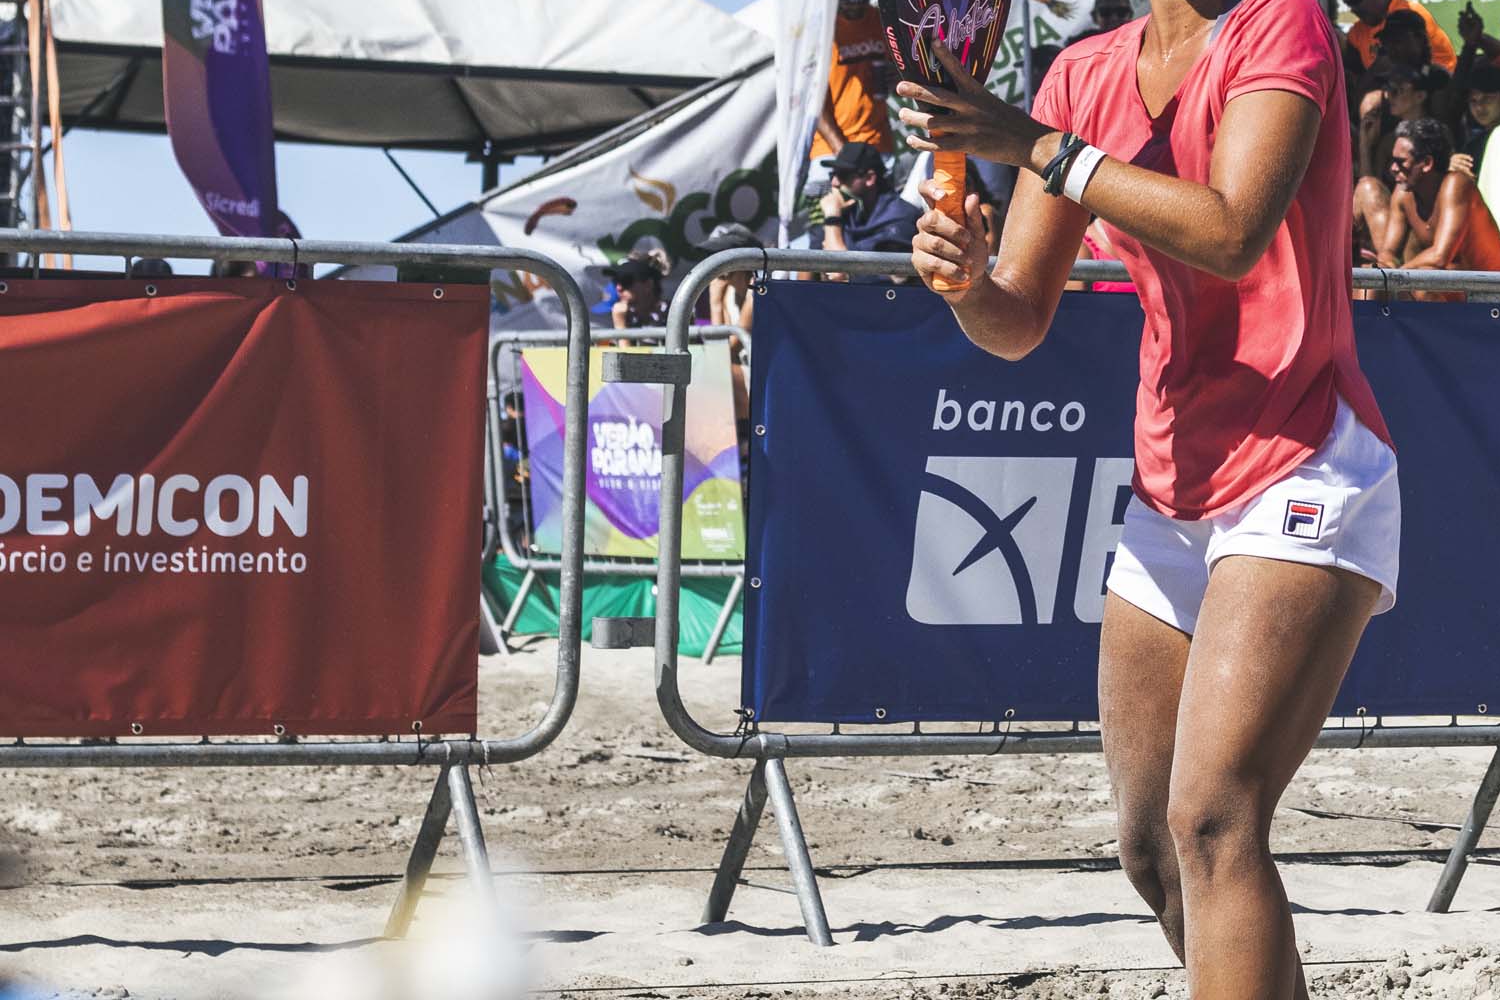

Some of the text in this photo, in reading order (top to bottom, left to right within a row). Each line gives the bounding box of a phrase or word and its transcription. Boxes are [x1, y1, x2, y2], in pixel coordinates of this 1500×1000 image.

[932, 389, 1087, 432] banco
[76, 551, 94, 574] e
[103, 544, 308, 574] investimento
